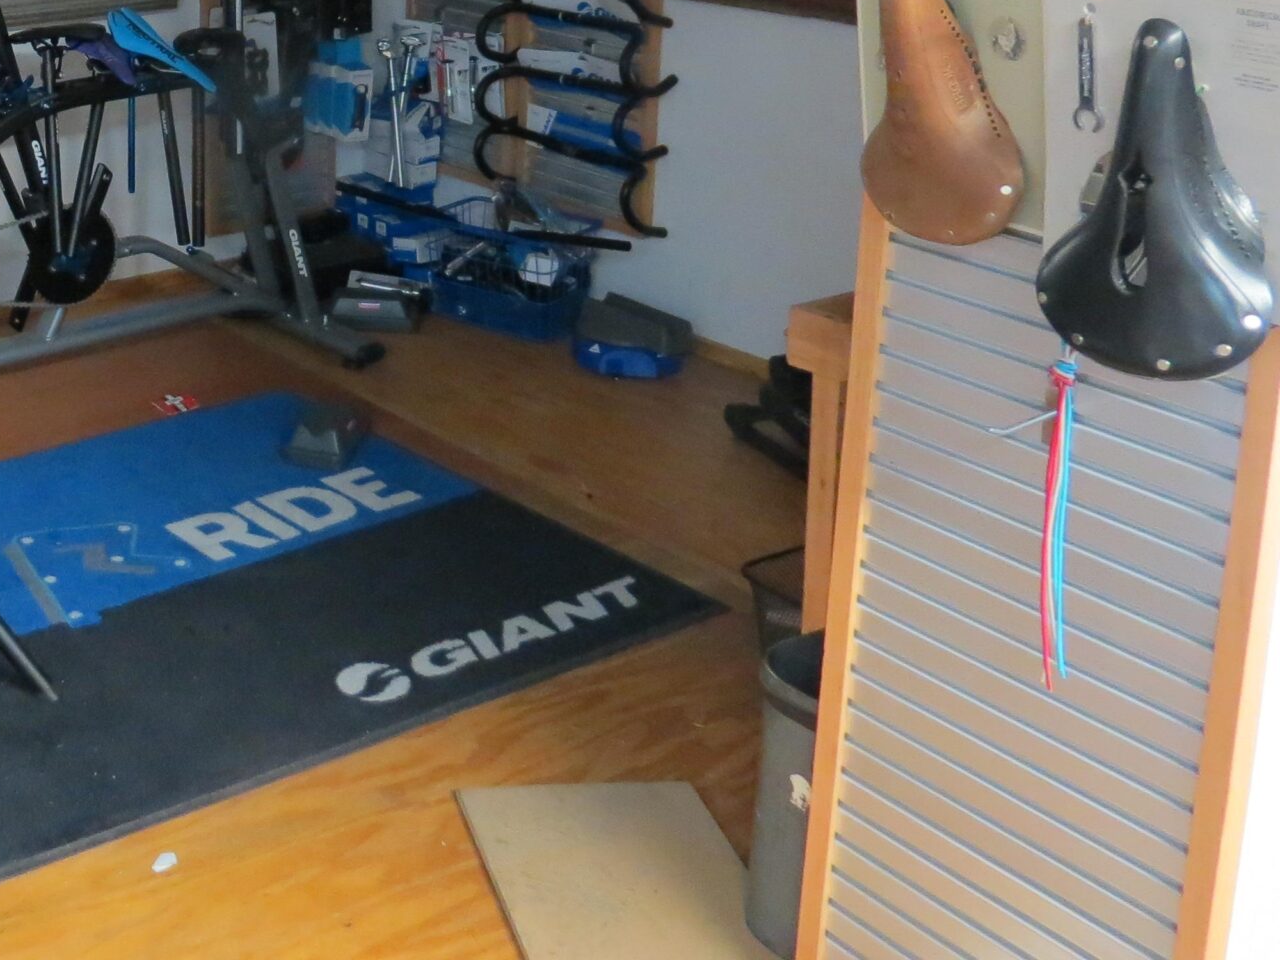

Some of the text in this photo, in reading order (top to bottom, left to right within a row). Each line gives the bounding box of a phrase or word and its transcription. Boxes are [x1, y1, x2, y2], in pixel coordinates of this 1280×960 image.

[31, 139, 48, 185] GIAN
[288, 228, 308, 278] GIANT
[164, 466, 422, 561] RIDE
[410, 575, 642, 678] GIANT
